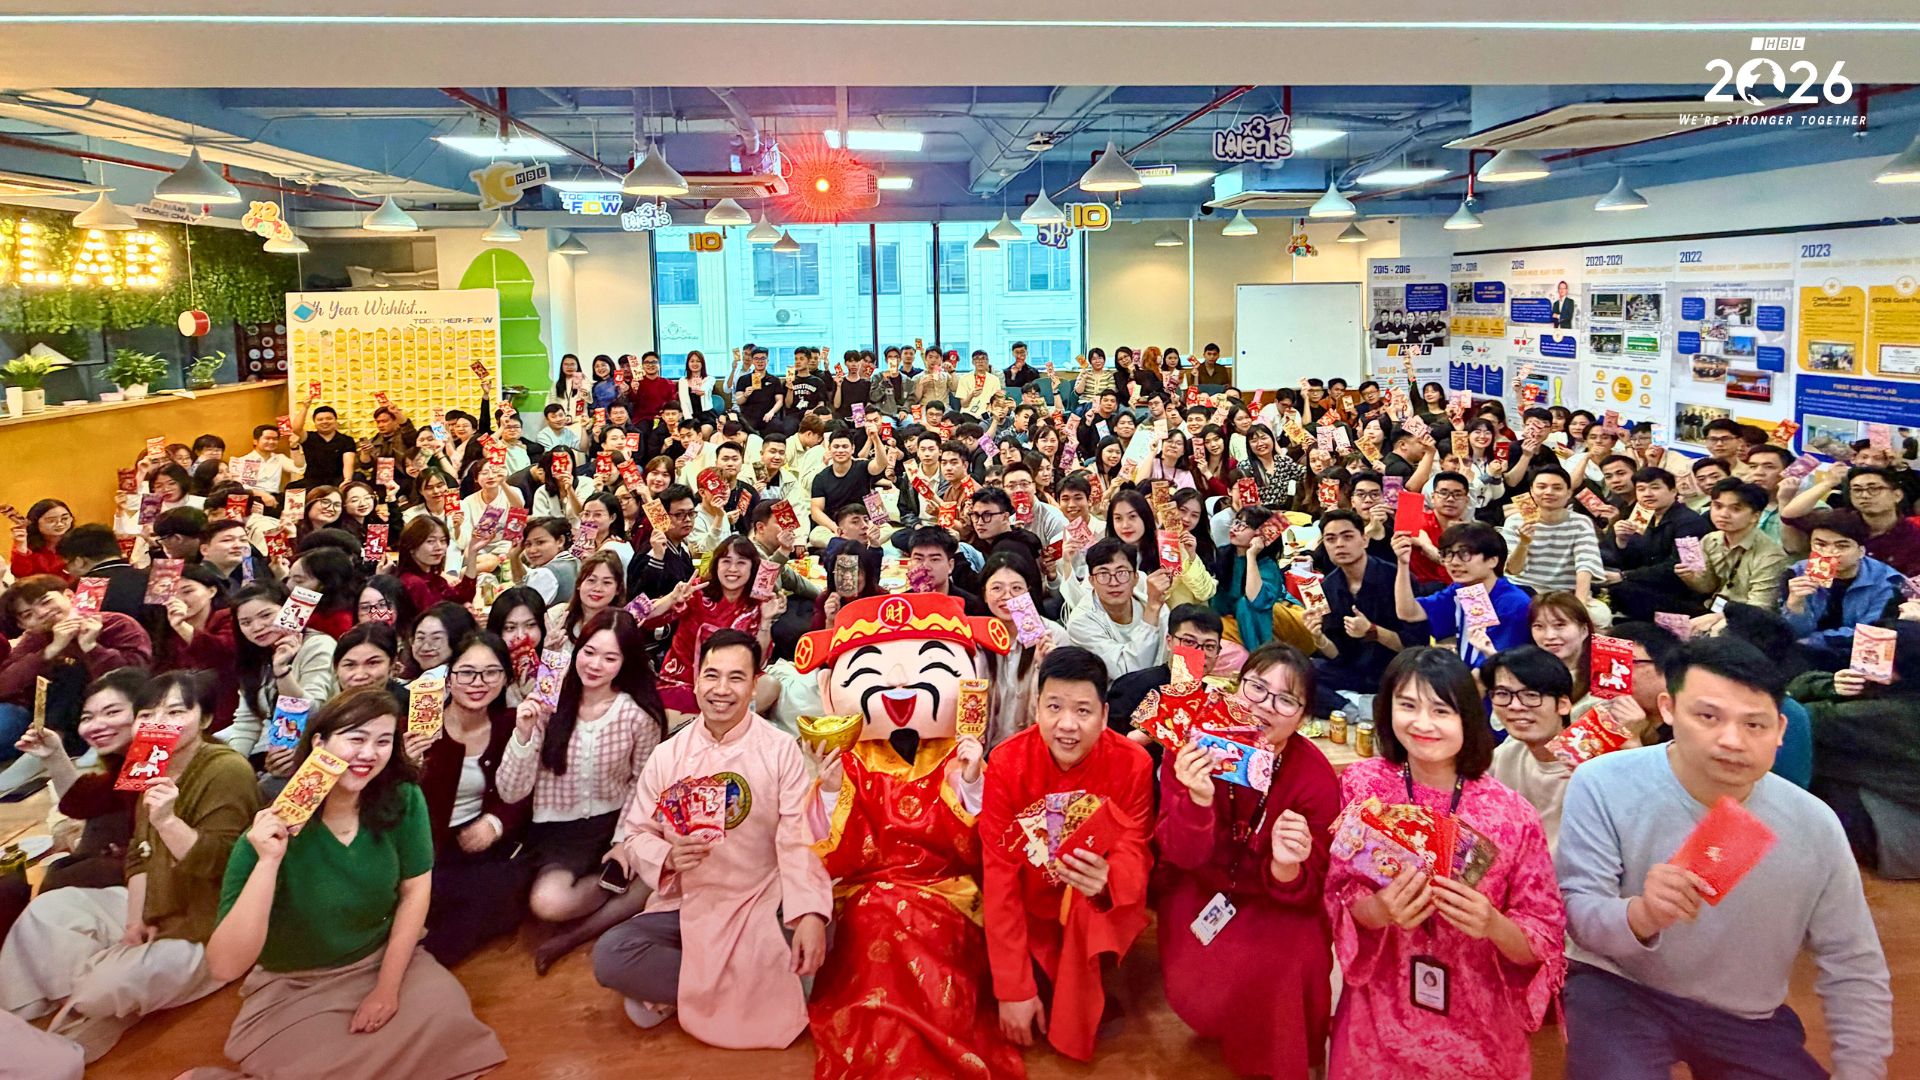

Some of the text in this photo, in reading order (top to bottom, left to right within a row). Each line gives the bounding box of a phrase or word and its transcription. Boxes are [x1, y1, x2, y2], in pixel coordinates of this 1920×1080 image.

[1242, 117, 1266, 138] x3
[515, 167, 547, 185] HBL
[0, 220, 169, 286] LAB
[1679, 251, 1702, 263] 2022
[1801, 243, 1831, 258] 2023
[1512, 260, 1525, 270] 2019
[1585, 254, 1623, 267] 2020-2021
[1373, 265, 1389, 274] 2015
[1395, 264, 1411, 274] 2016
[329, 301, 360, 319] Year
